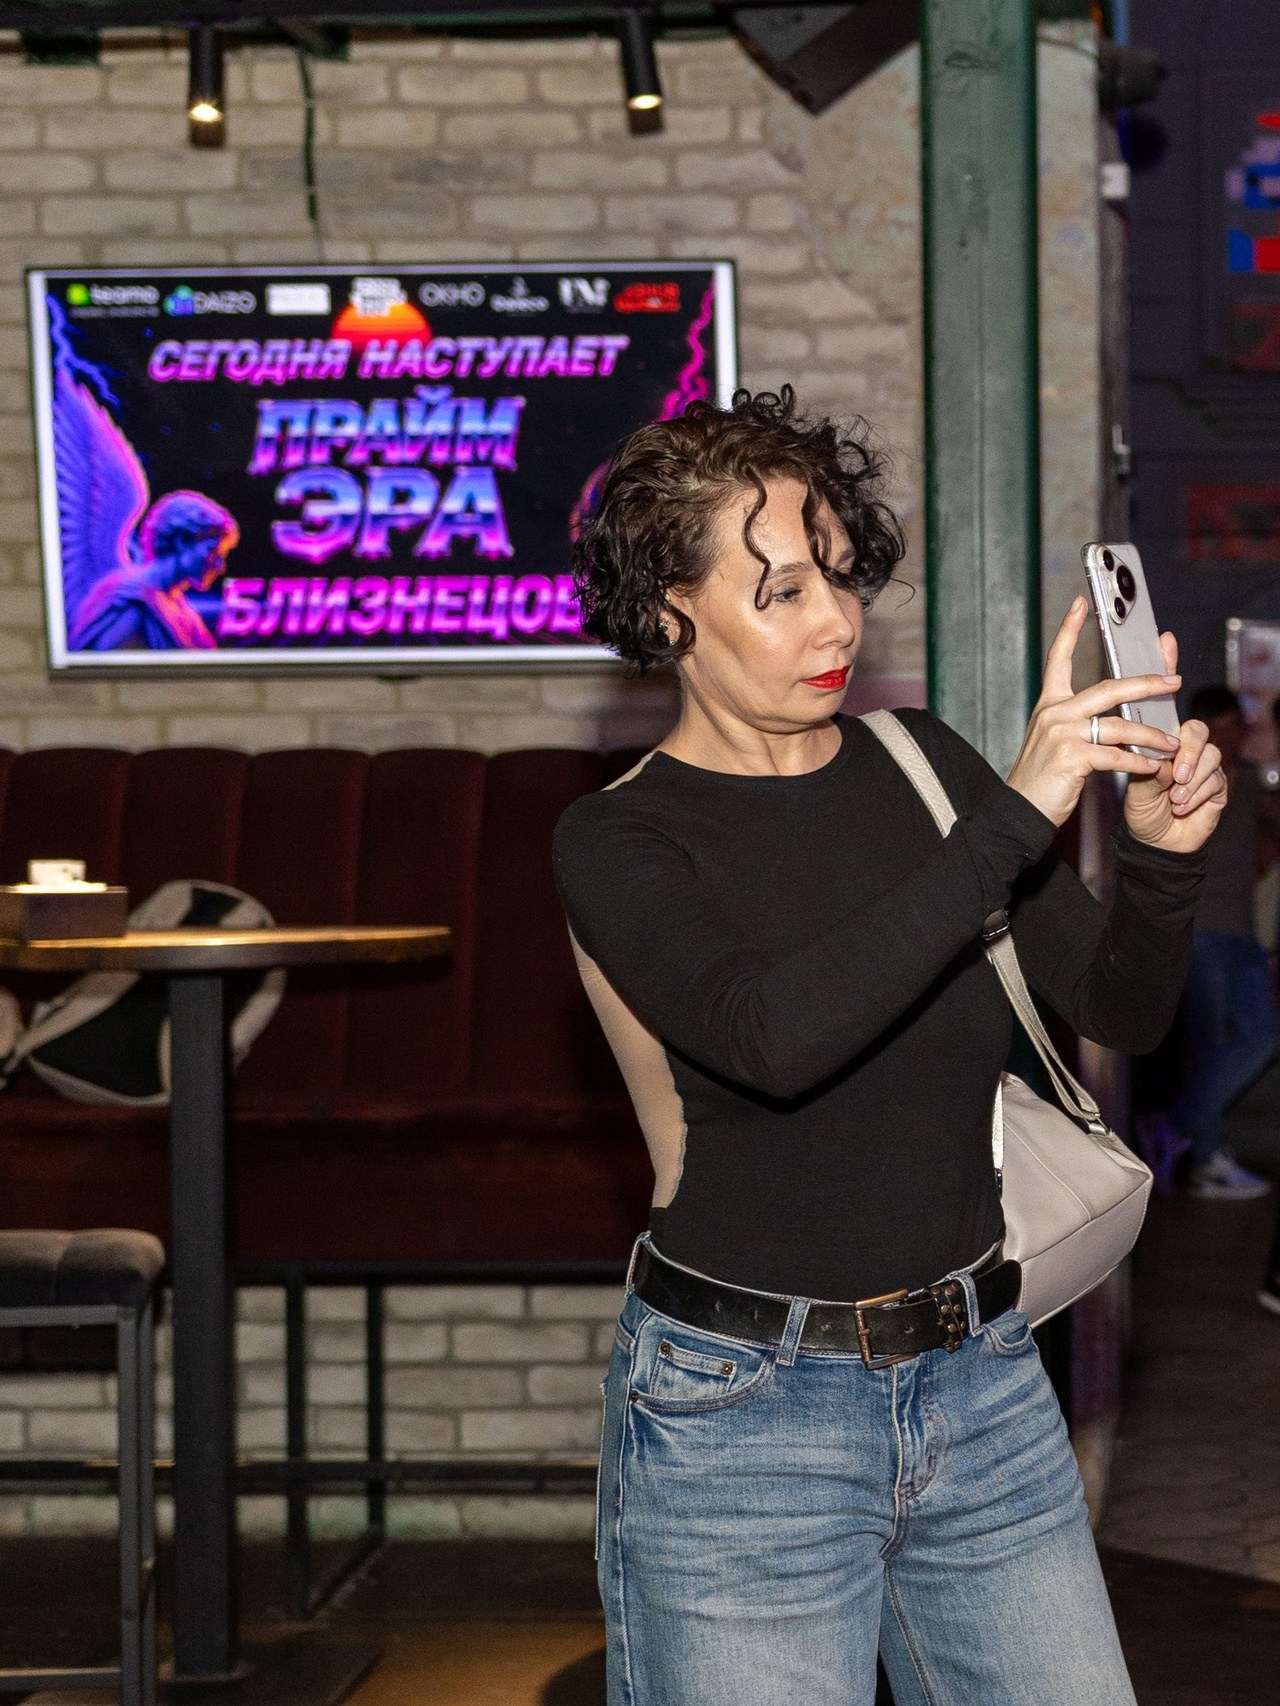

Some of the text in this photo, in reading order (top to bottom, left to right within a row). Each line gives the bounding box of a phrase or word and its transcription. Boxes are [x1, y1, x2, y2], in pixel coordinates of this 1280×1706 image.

[148, 335, 630, 384] СЕГОДНЯ НАСТУПАЕТ
[247, 385, 526, 475] ПРАЙМ
[271, 466, 514, 564] ЭРА
